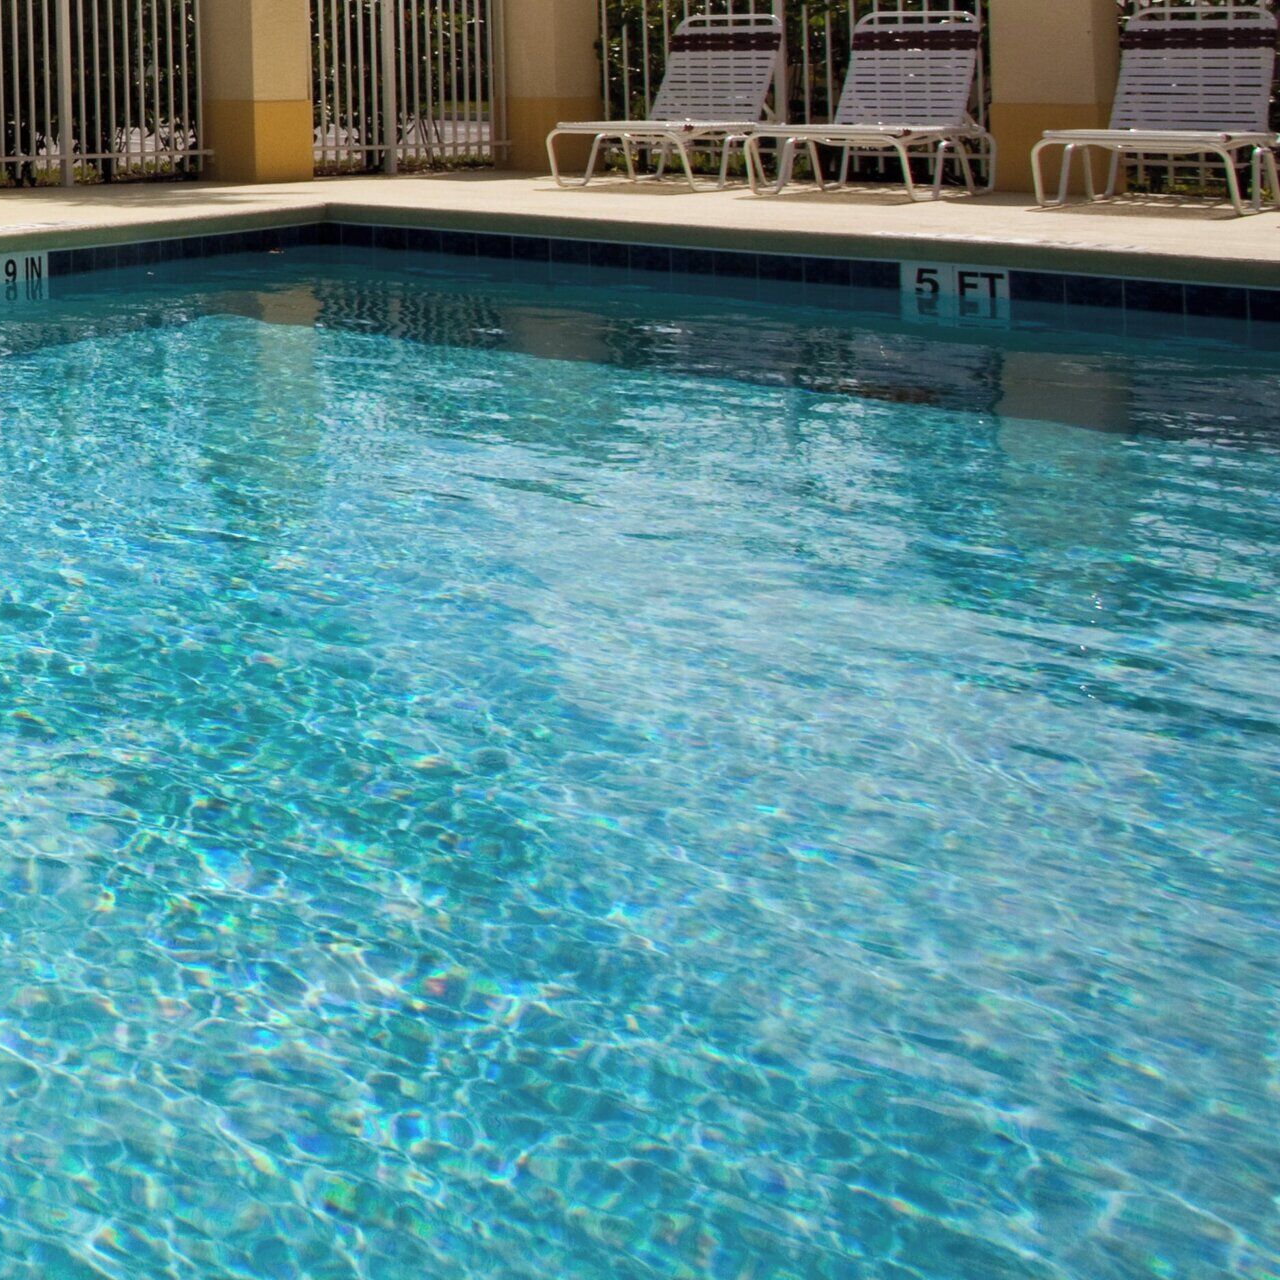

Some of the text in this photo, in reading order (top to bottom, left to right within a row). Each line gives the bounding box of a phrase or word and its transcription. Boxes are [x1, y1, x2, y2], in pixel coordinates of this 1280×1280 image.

[5, 259, 17, 283] 9
[25, 256, 42, 280] IN
[915, 267, 1005, 298] 5 FT
